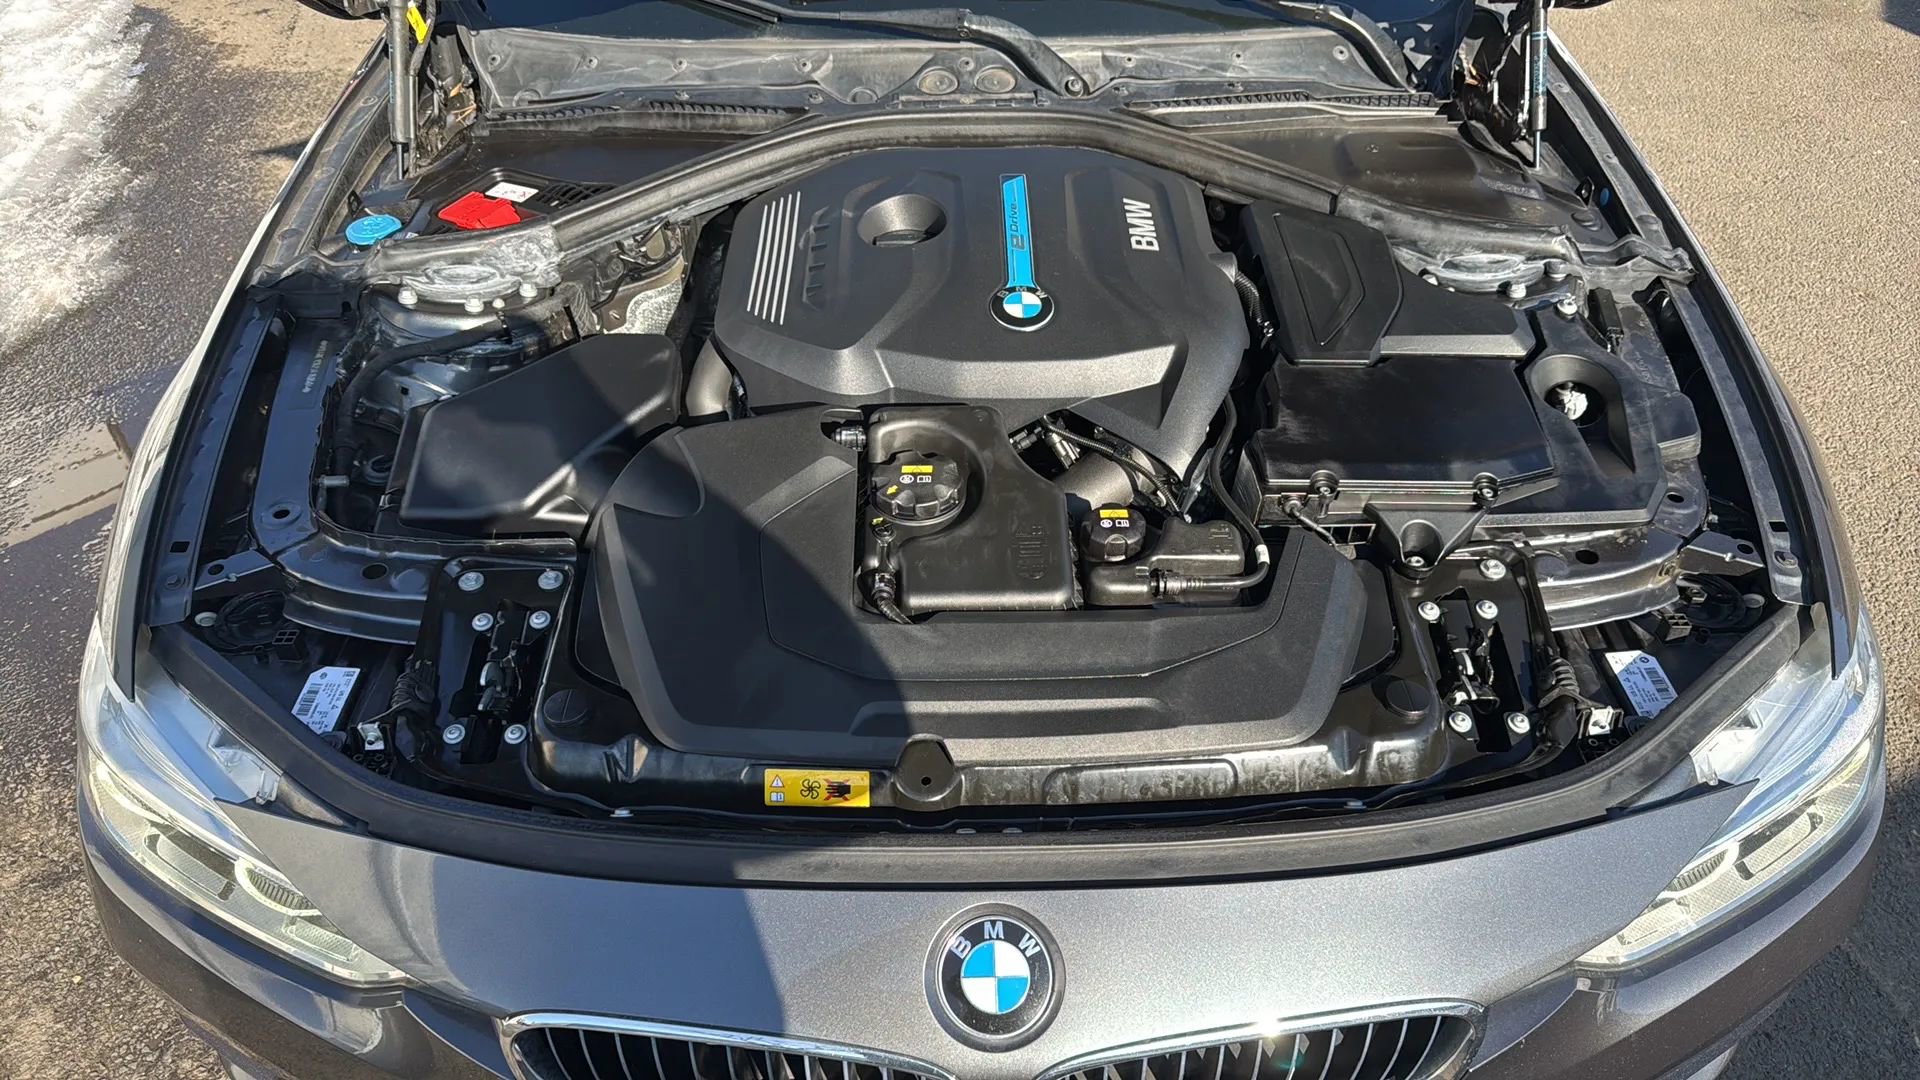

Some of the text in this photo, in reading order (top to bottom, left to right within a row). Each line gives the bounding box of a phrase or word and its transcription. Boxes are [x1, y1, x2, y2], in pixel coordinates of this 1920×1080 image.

[1122, 197, 1160, 252] BMW
[996, 285, 1048, 300] BMW
[949, 920, 1042, 960] BMW
